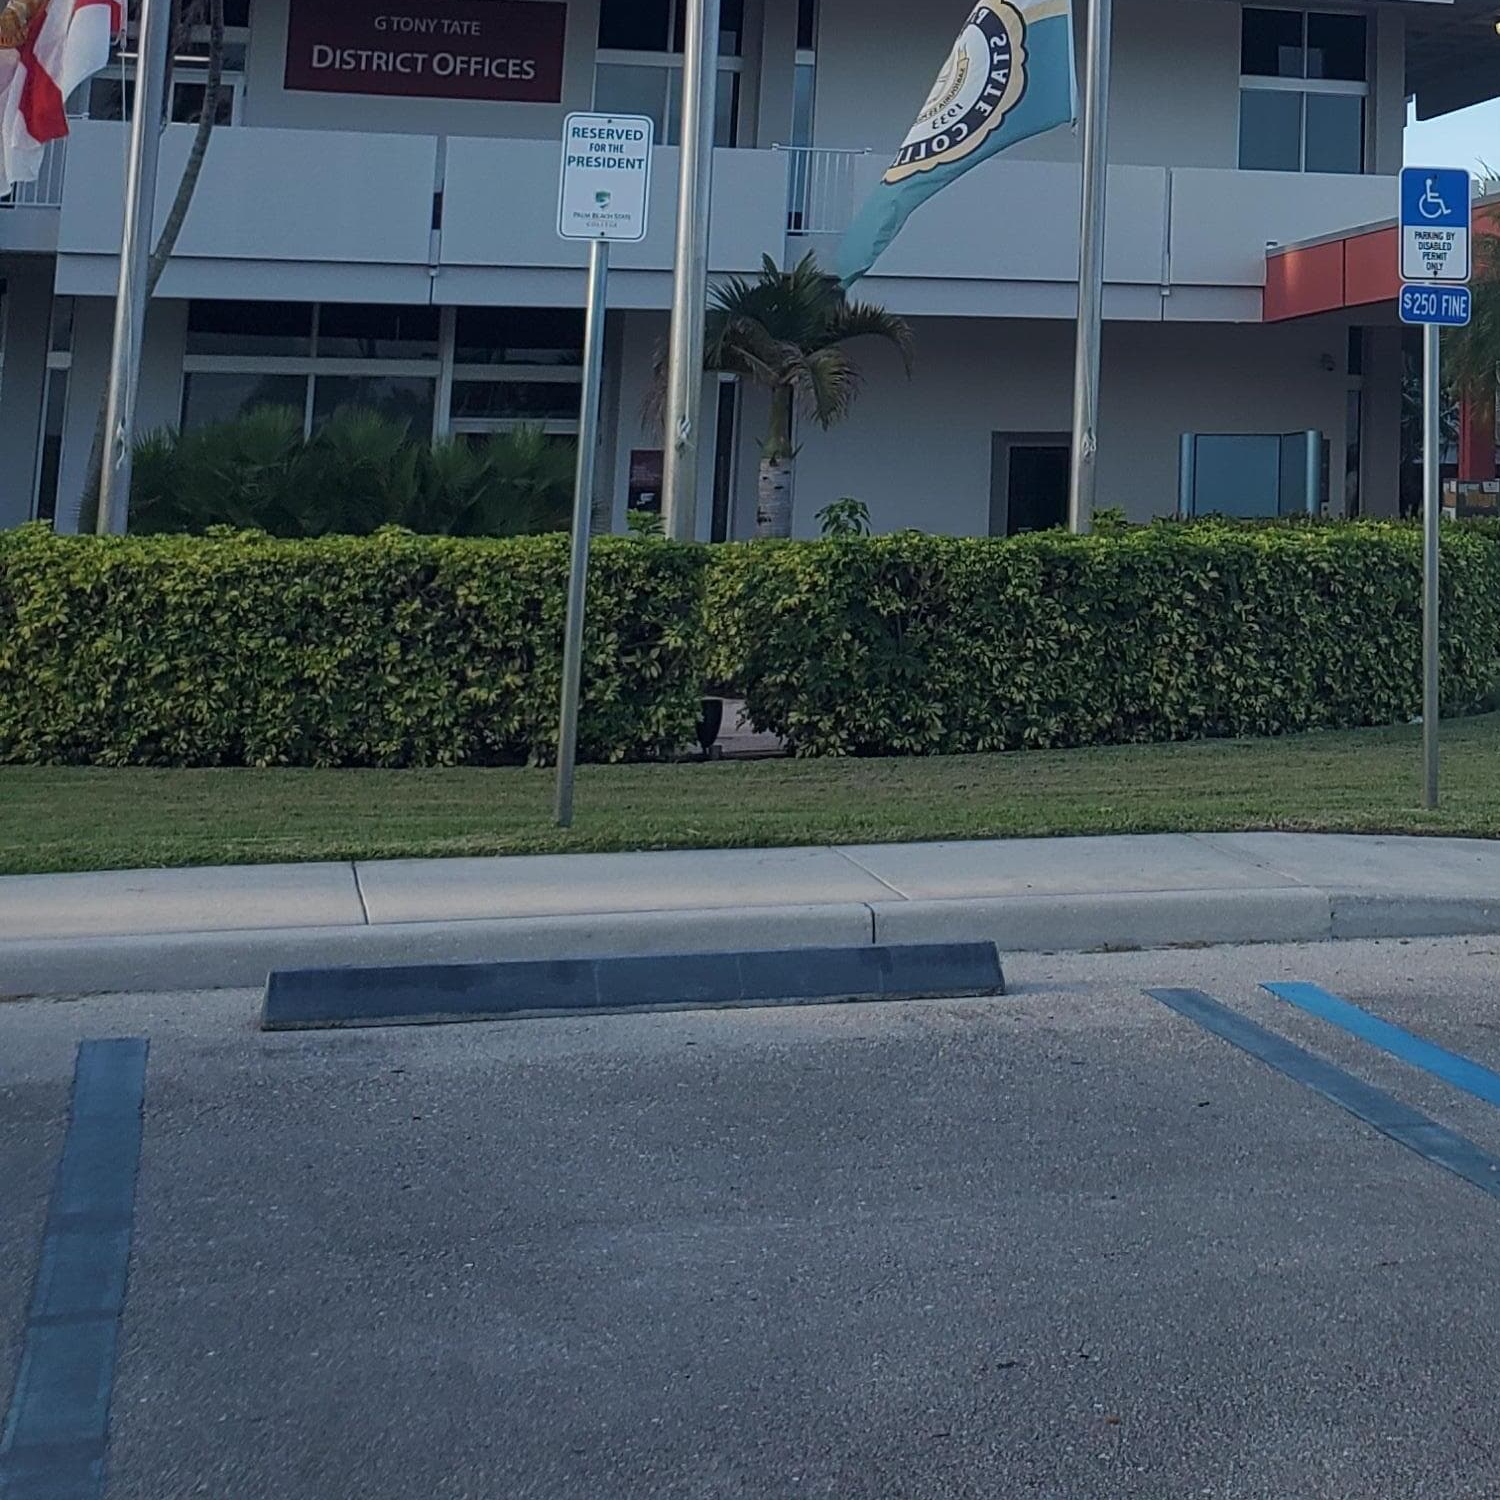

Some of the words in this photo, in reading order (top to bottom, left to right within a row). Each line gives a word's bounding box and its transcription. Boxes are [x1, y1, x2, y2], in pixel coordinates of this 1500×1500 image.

[374, 16, 387, 31] G
[390, 17, 438, 34] TONY
[442, 20, 481, 36] TATE
[311, 44, 428, 73] DISTRICT
[432, 53, 536, 80] OFFICES
[572, 126, 644, 141] RESERVED
[589, 143, 606, 153] FOR
[608, 144, 624, 154] THE
[567, 155, 645, 169] PRESIDENT
[1414, 231, 1444, 241] PARKING
[1446, 232, 1455, 241] BY
[1418, 242, 1452, 251] DISABLED
[1422, 252, 1447, 261] PERMIT
[1426, 262, 1443, 271] ONLY
[1404, 293, 1437, 316] $250
[1441, 295, 1467, 317] FINE
